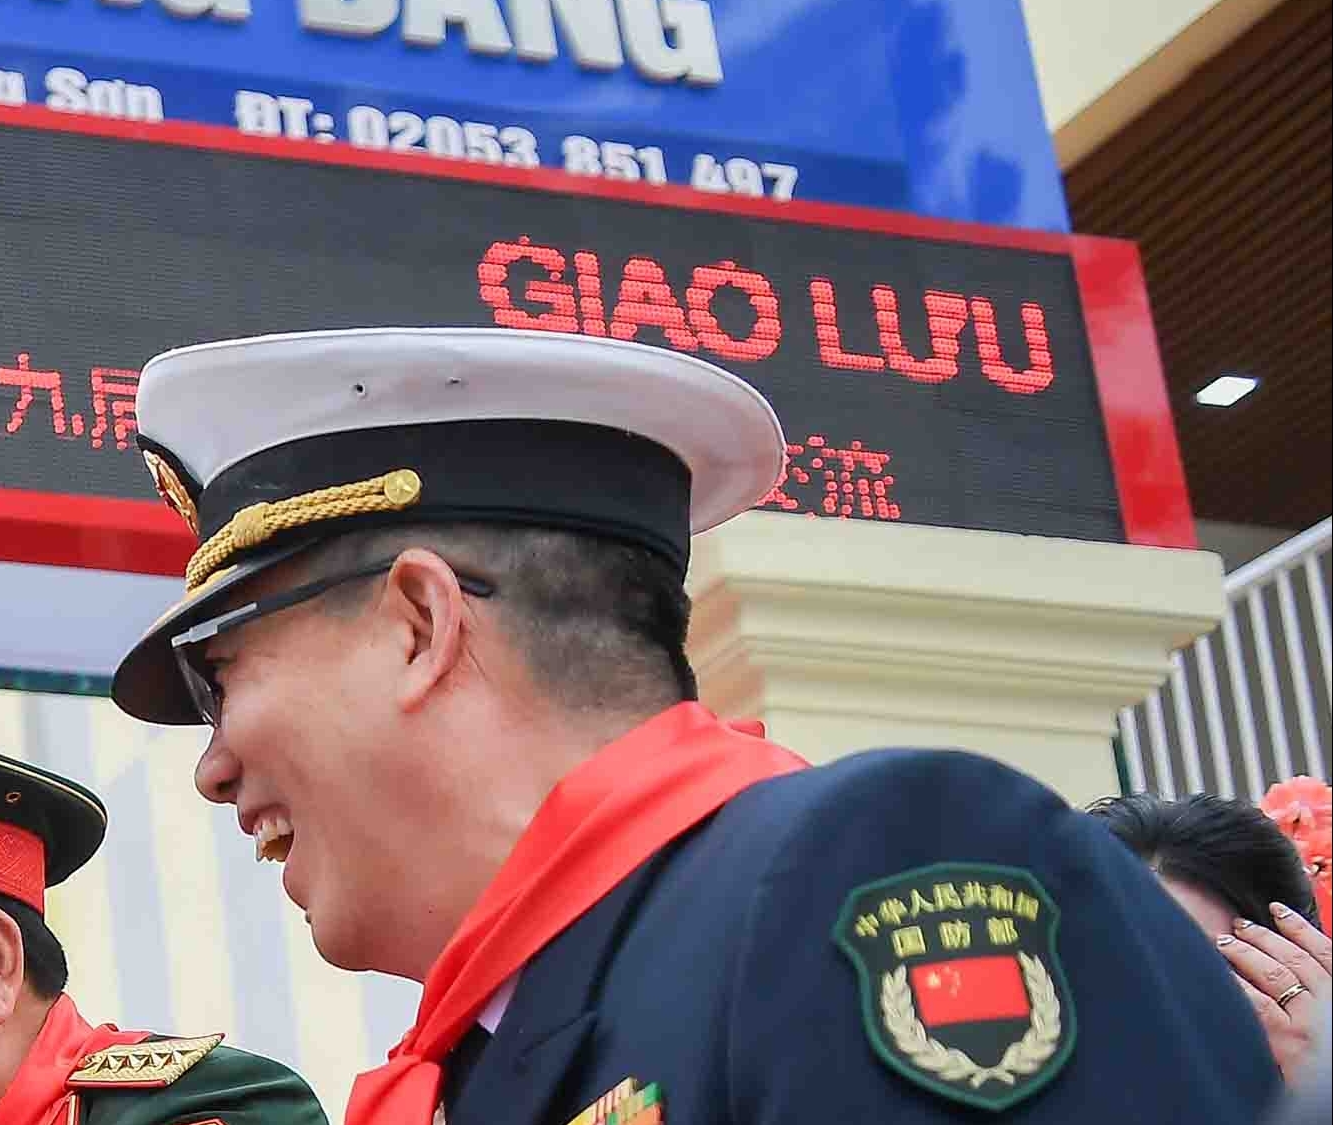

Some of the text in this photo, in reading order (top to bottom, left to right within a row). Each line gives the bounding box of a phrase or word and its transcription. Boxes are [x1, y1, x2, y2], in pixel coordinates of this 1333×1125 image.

[346, 105, 541, 168] 02053
[563, 134, 668, 186] 851
[691, 153, 799, 202] 497
[477, 235, 782, 361] GIAO
